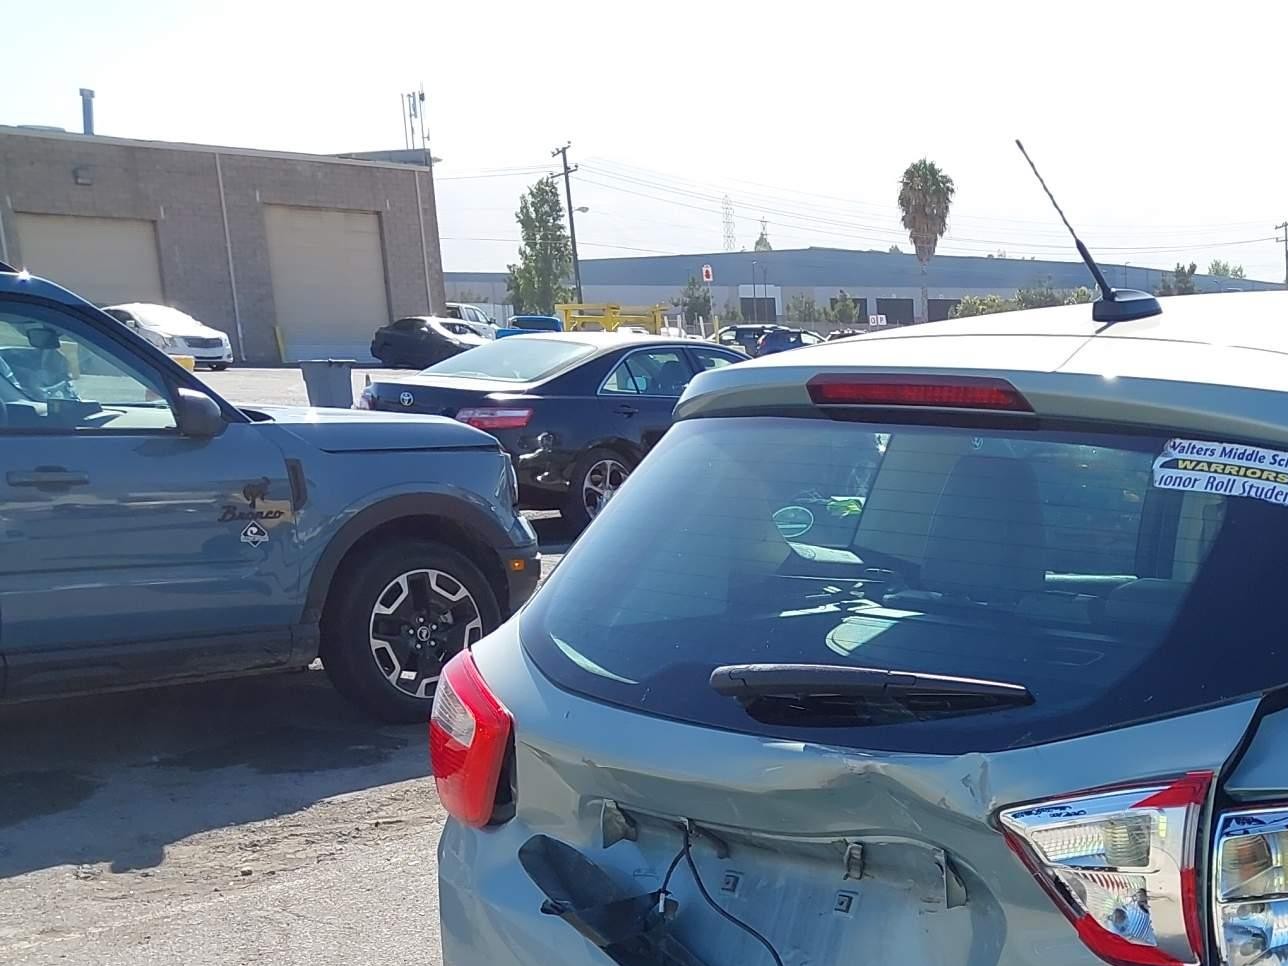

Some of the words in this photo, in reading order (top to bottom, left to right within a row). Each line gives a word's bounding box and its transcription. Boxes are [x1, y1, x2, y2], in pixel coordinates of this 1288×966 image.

[1219, 446, 1266, 464] Middle
[1204, 474, 1237, 494] Roll
[217, 504, 284, 522] Bronco
